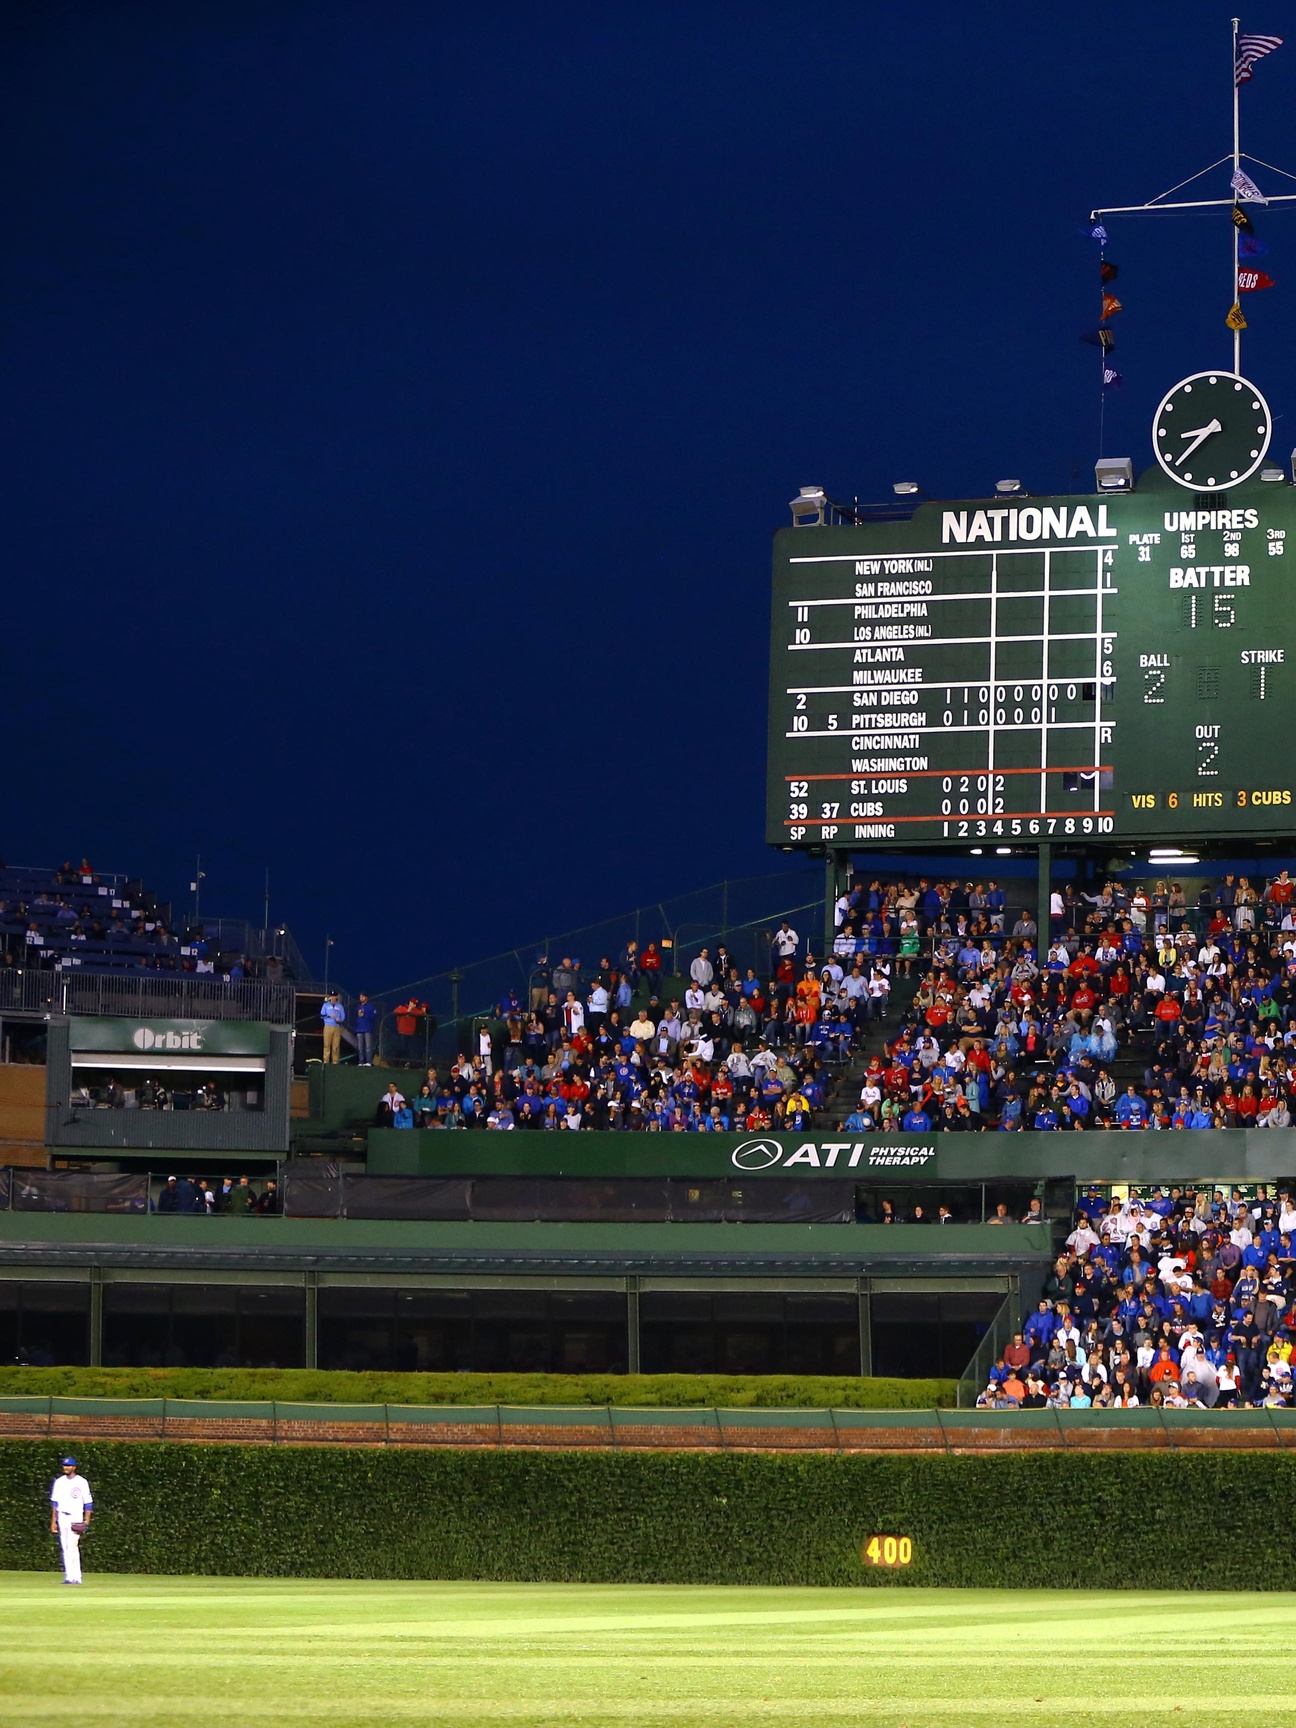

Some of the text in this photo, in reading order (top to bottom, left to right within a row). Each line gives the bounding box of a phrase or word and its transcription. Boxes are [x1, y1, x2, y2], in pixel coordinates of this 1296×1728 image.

[942, 505, 1117, 543] NATIONAL
[1164, 509, 1258, 532] UMPIRES
[1129, 529, 1285, 544] PLATE 1ST 2ND 3RD
[1138, 541, 1283, 561] 31 65 98 55
[856, 561, 881, 575] NEW
[1104, 550, 1113, 566] 4
[1170, 566, 1250, 588] BATTER
[855, 583, 874, 597] SAN
[878, 580, 932, 596] FRANCISCO
[798, 603, 927, 622] 11 PHILADELPHIA
[796, 628, 810, 644] 10
[854, 626, 871, 640] LOS
[854, 639, 1112, 662] ATLANTA 5
[1140, 654, 1170, 667] BALL
[1241, 650, 1284, 663] STRIKE
[853, 661, 1112, 684] MILWAUKEE 6
[1144, 670, 1164, 703] 2
[796, 690, 918, 709] 2 SAN DIEGO
[794, 712, 926, 731] 10 5 PITTSBURGH
[1196, 726, 1220, 738] OUT
[852, 728, 1111, 750] CINCINNATI R
[852, 757, 928, 772] WASHINGTON
[1198, 742, 1218, 775] 2
[790, 776, 1004, 797] 52 ST. LOUIS 0 2 0 2
[790, 798, 1003, 819] 39 37 CUBS 0 0 0 2
[1132, 791, 1291, 808] VIS 6 HITS 3 CUBS
[790, 827, 806, 840] SP
[822, 826, 838, 839] RP
[855, 824, 894, 838] INNING
[958, 821, 968, 836] 2
[976, 821, 986, 836] 3
[993, 820, 1003, 835] 4
[1012, 820, 1021, 835] 5
[1030, 820, 1039, 834] 6
[1047, 819, 1056, 834] 7
[1065, 818, 1075, 833] 8
[1083, 818, 1092, 833] 9
[1098, 817, 1113, 832] 10
[134, 1028, 202, 1049] Orbit
[782, 1144, 864, 1167] ATI
[868, 1156, 928, 1166] THERAPY
[870, 1147, 935, 1156] PHYSICAL
[866, 1536, 912, 1564] 400
